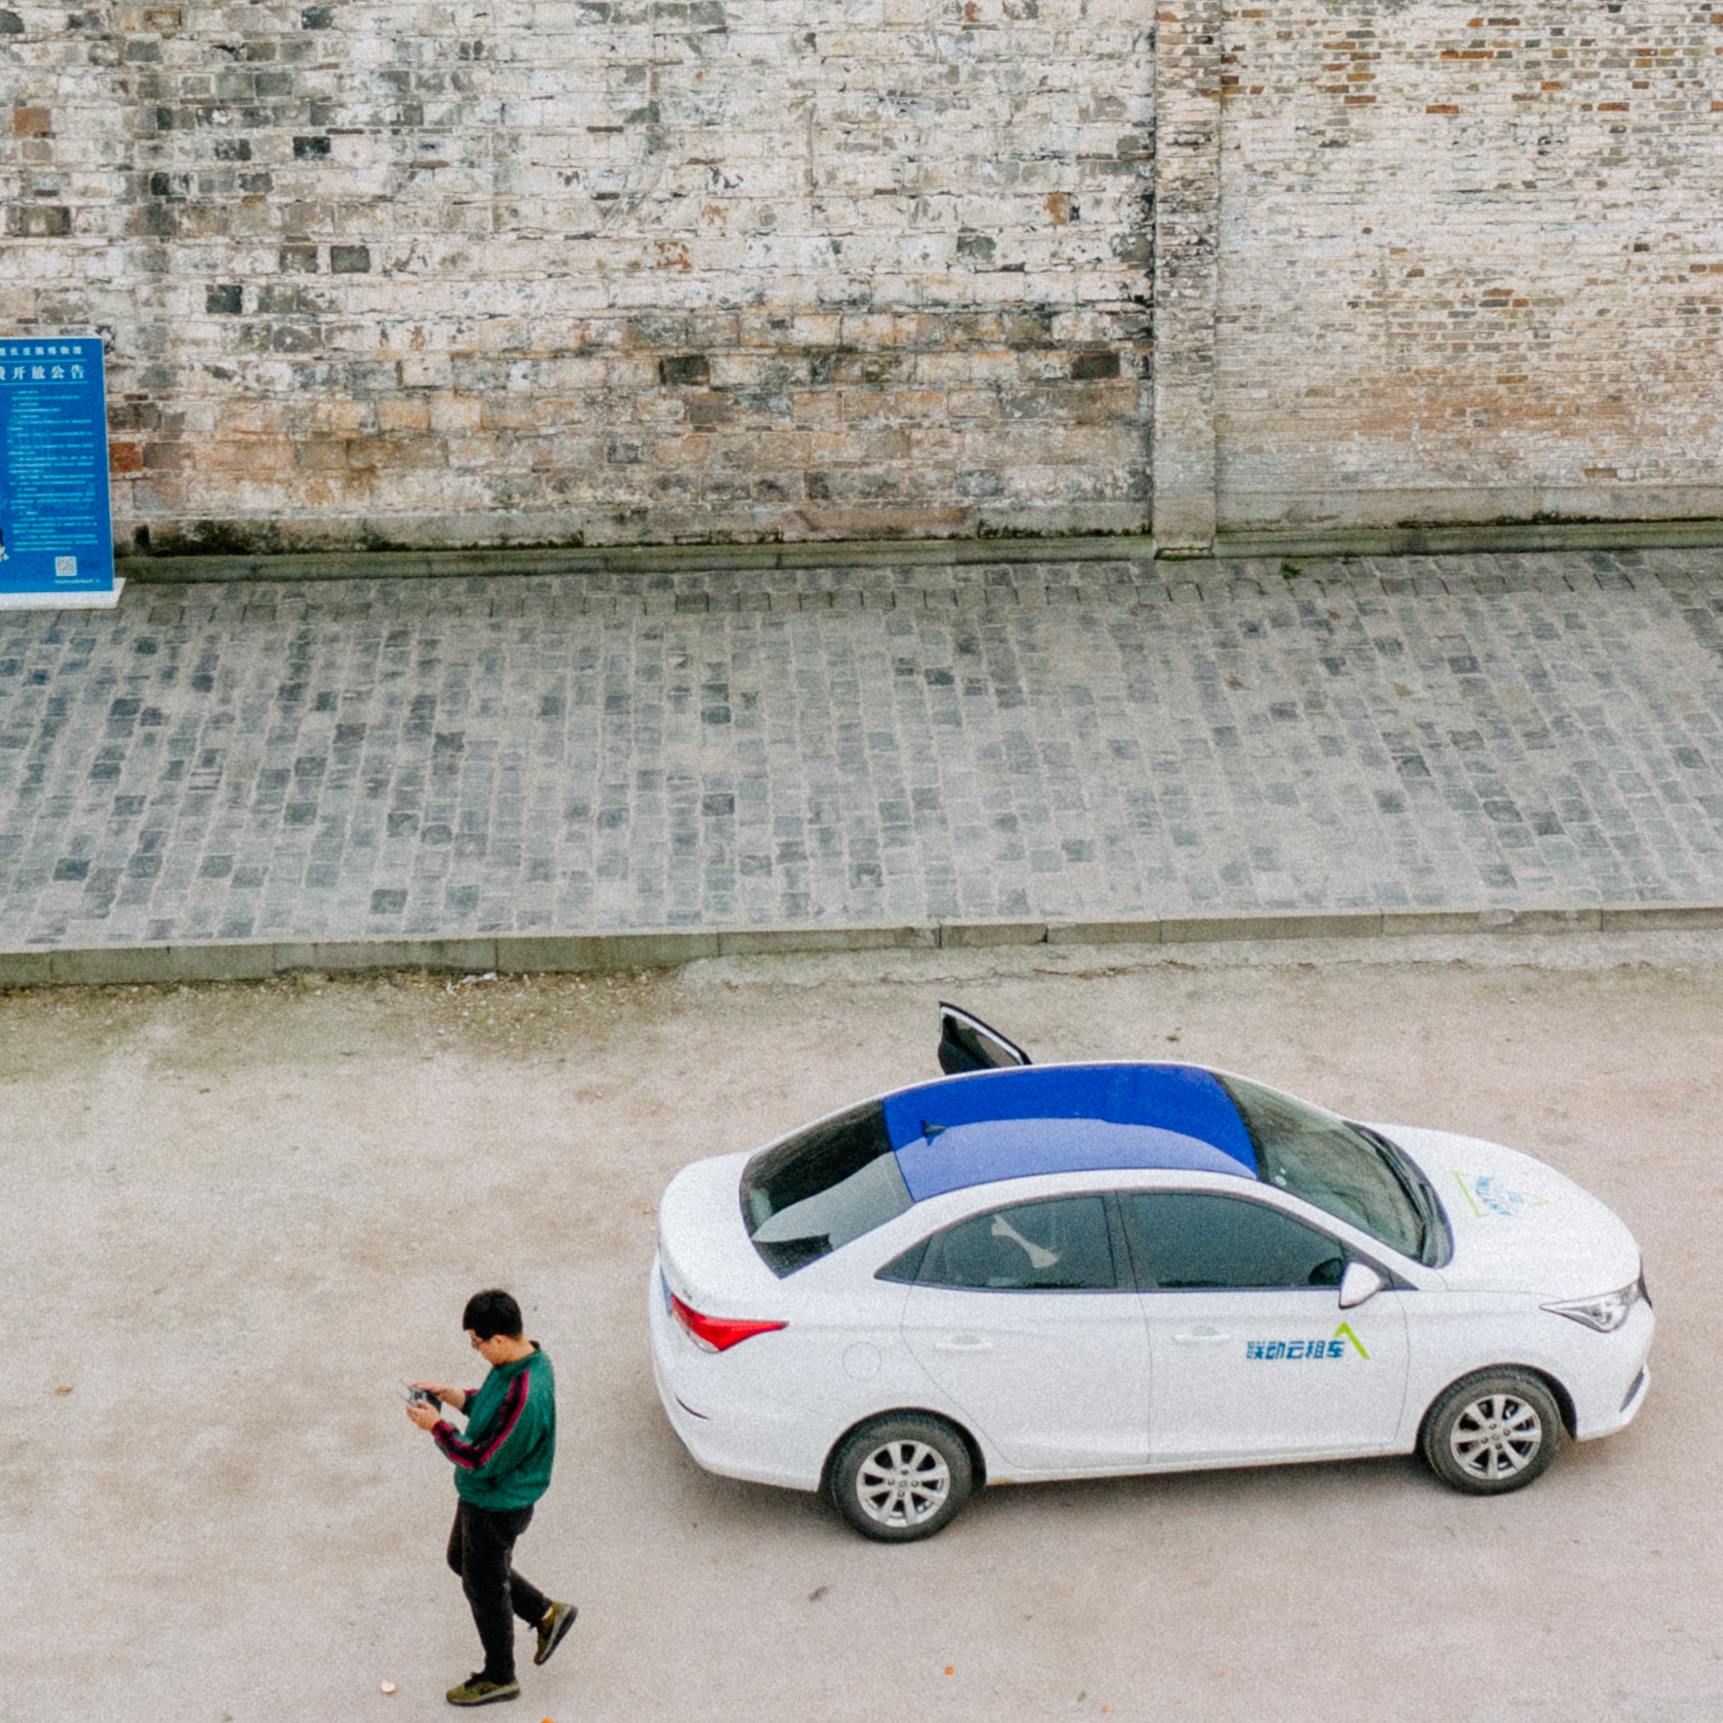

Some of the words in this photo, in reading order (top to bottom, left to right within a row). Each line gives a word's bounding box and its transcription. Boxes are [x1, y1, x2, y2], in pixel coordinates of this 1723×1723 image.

[1246, 1340, 1345, 1360] 联动云租车
